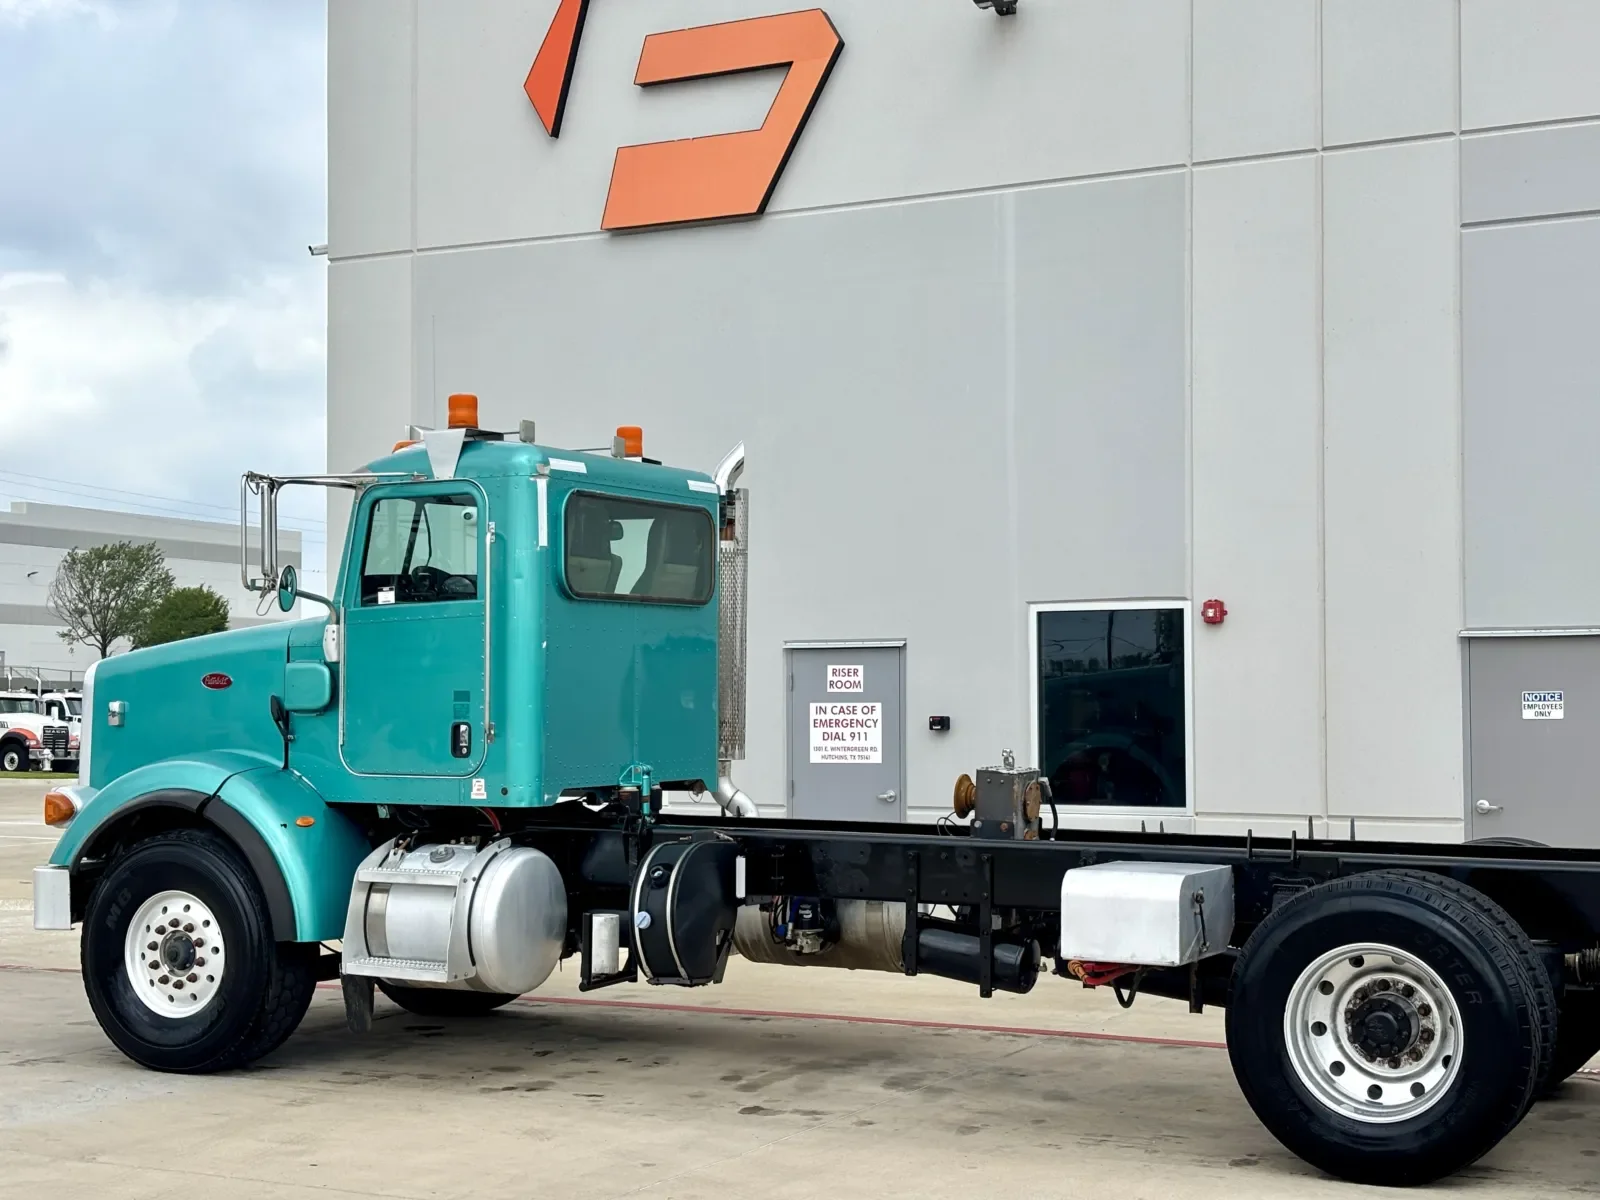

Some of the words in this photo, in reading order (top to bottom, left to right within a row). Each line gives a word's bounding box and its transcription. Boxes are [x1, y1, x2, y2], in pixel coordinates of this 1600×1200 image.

[832, 668, 859, 677] RISER
[829, 680, 862, 689] ROOM
[1524, 693, 1561, 701] NOTICE
[815, 706, 827, 715] IN
[831, 705, 858, 715] CASE
[861, 706, 876, 715] OF
[813, 719, 878, 728] EMERGENCY
[822, 732, 846, 741] DIAL
[849, 732, 868, 741] 911
